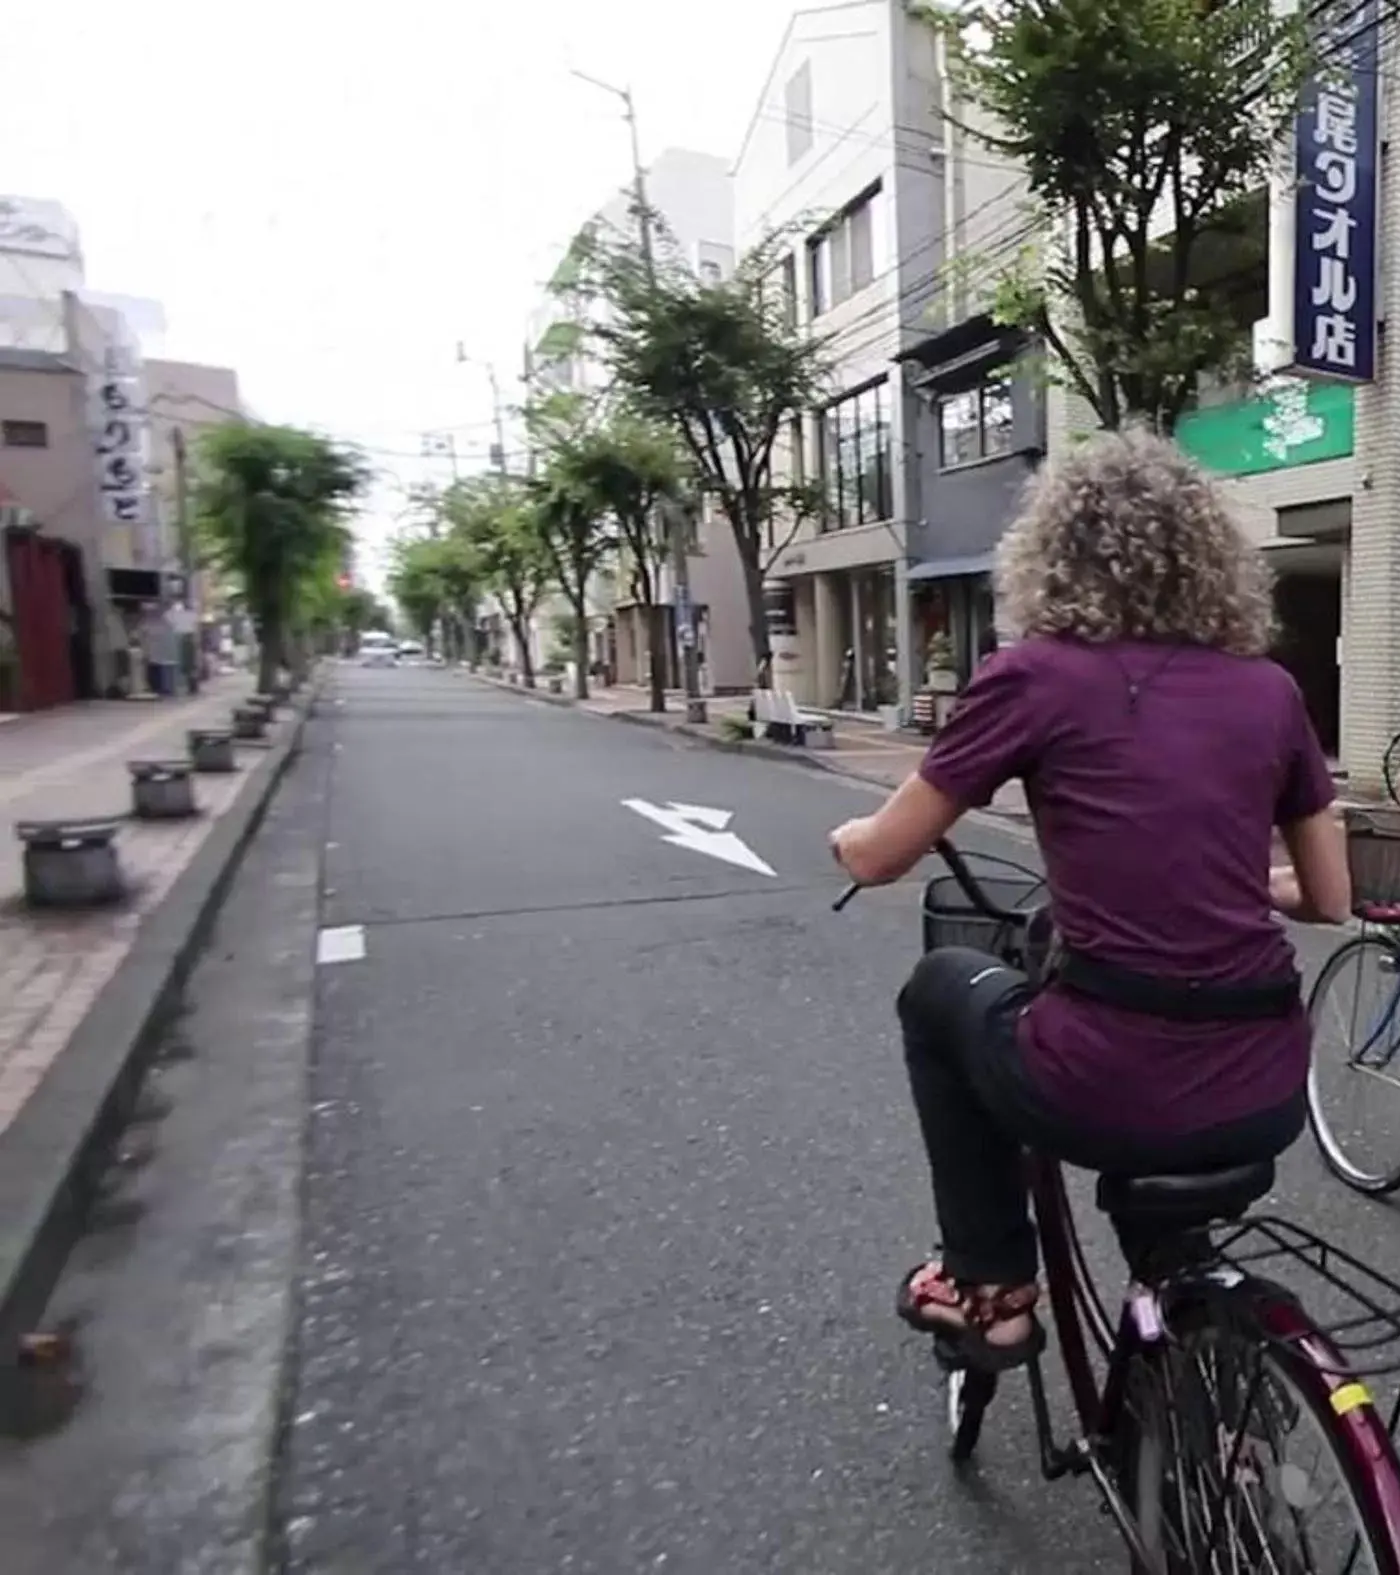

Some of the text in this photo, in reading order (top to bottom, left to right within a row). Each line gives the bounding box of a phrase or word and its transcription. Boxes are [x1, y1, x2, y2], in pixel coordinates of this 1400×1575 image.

[1312, 50, 1358, 368] 尾タオル店
